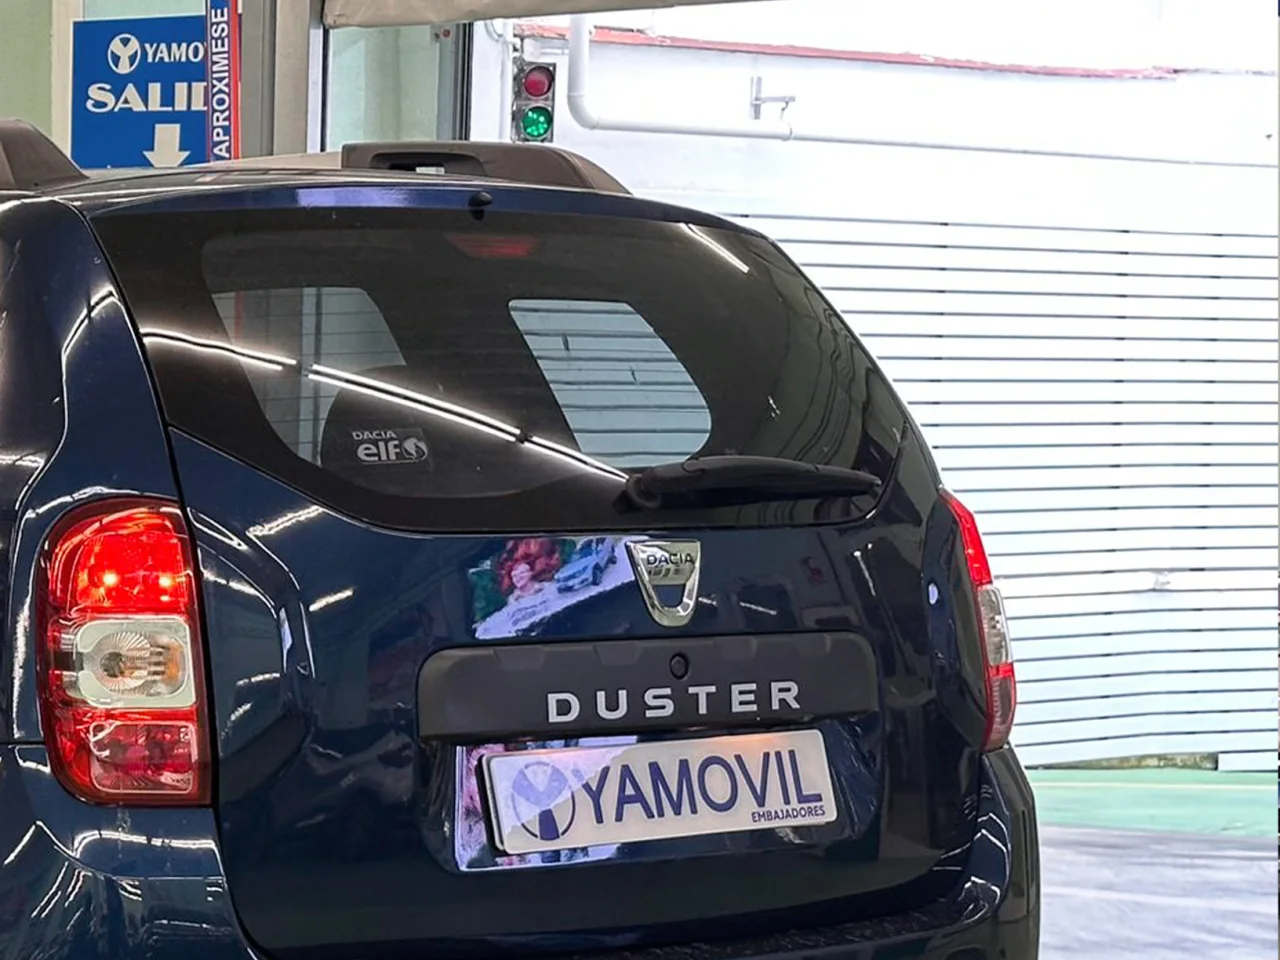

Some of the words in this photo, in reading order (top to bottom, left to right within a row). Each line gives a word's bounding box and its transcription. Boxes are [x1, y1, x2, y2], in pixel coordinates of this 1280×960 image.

[144, 41, 207, 63] YAMO
[210, 7, 230, 158] APROXIMESE
[352, 430, 397, 440] DACIA
[357, 440, 400, 461] elf
[646, 553, 695, 565] DACIA
[547, 681, 801, 723] DUSTER
[572, 749, 823, 824] YAMOVIL
[751, 804, 826, 823] EMBAJADORES
